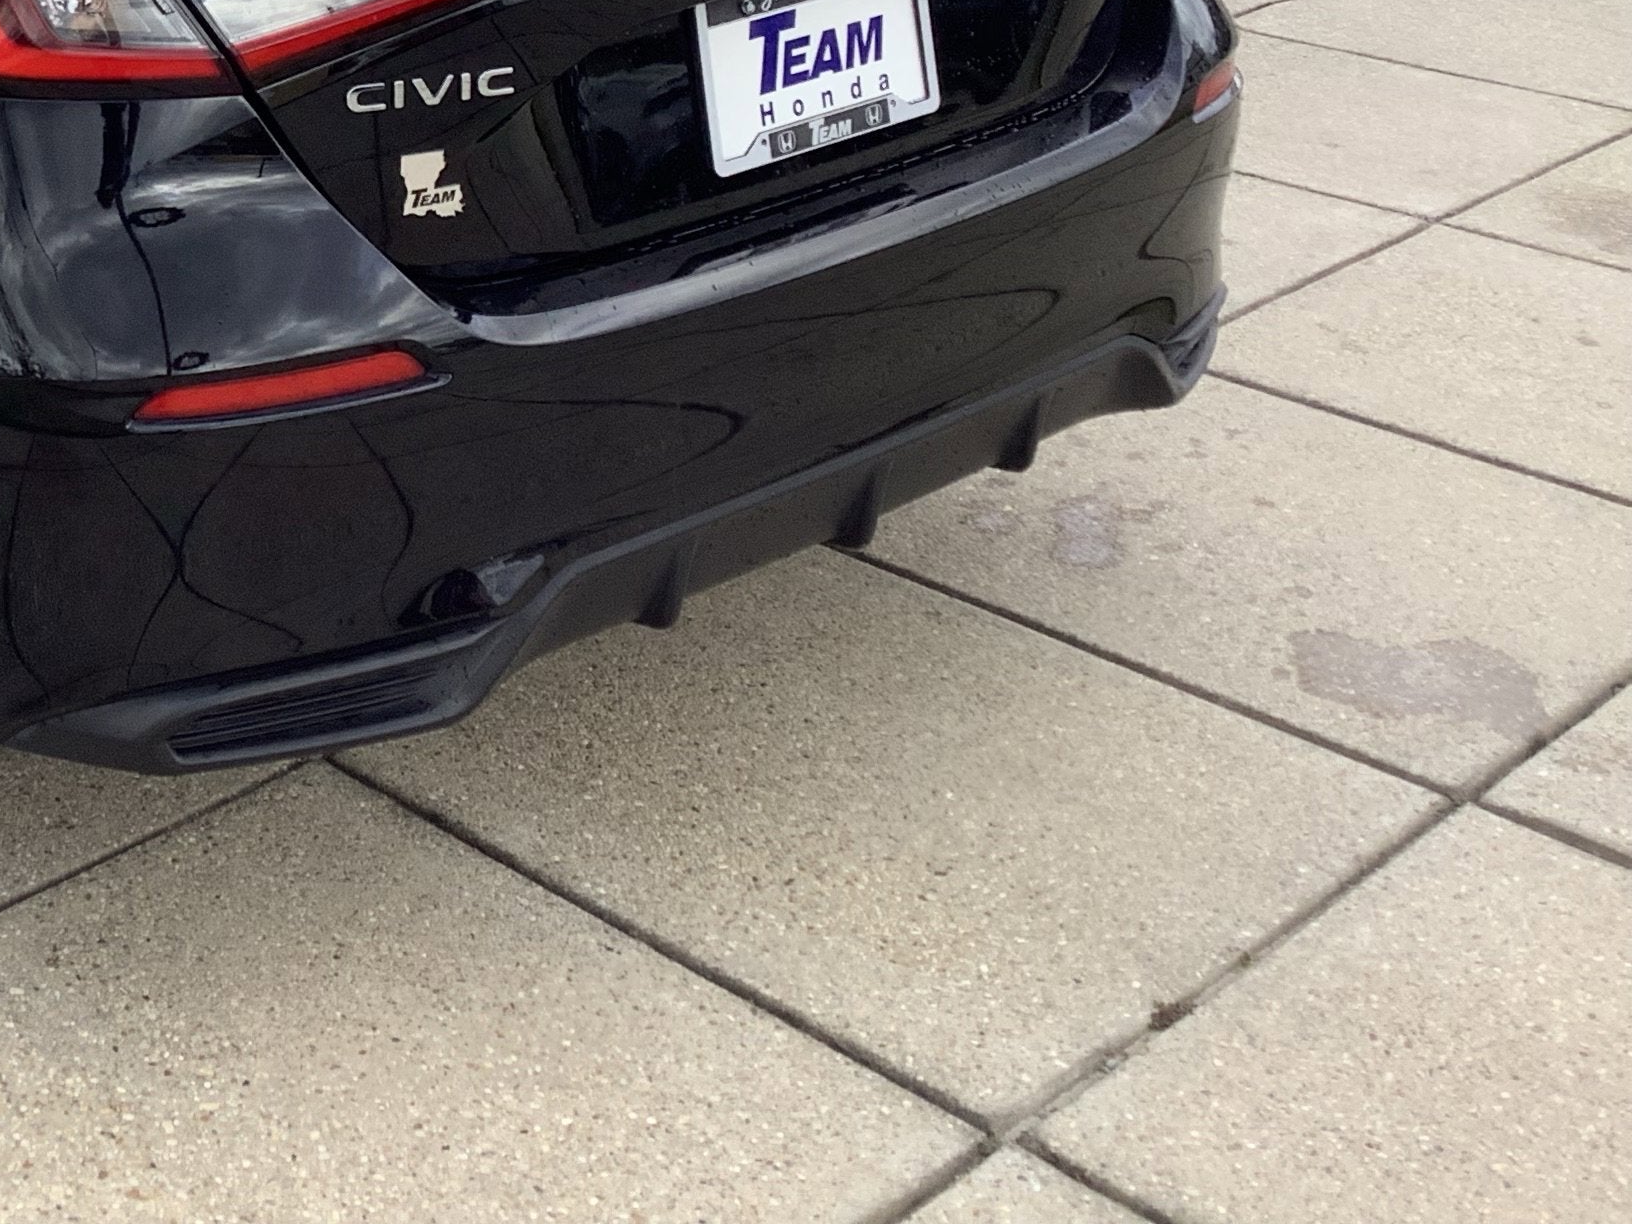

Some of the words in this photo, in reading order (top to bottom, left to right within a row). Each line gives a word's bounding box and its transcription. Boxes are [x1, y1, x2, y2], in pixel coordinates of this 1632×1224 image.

[748, 9, 884, 96] TEAM
[346, 66, 515, 114] CIVIC
[759, 73, 891, 127] Honda
[809, 118, 853, 147] TEAM
[410, 187, 457, 209] TEAM
